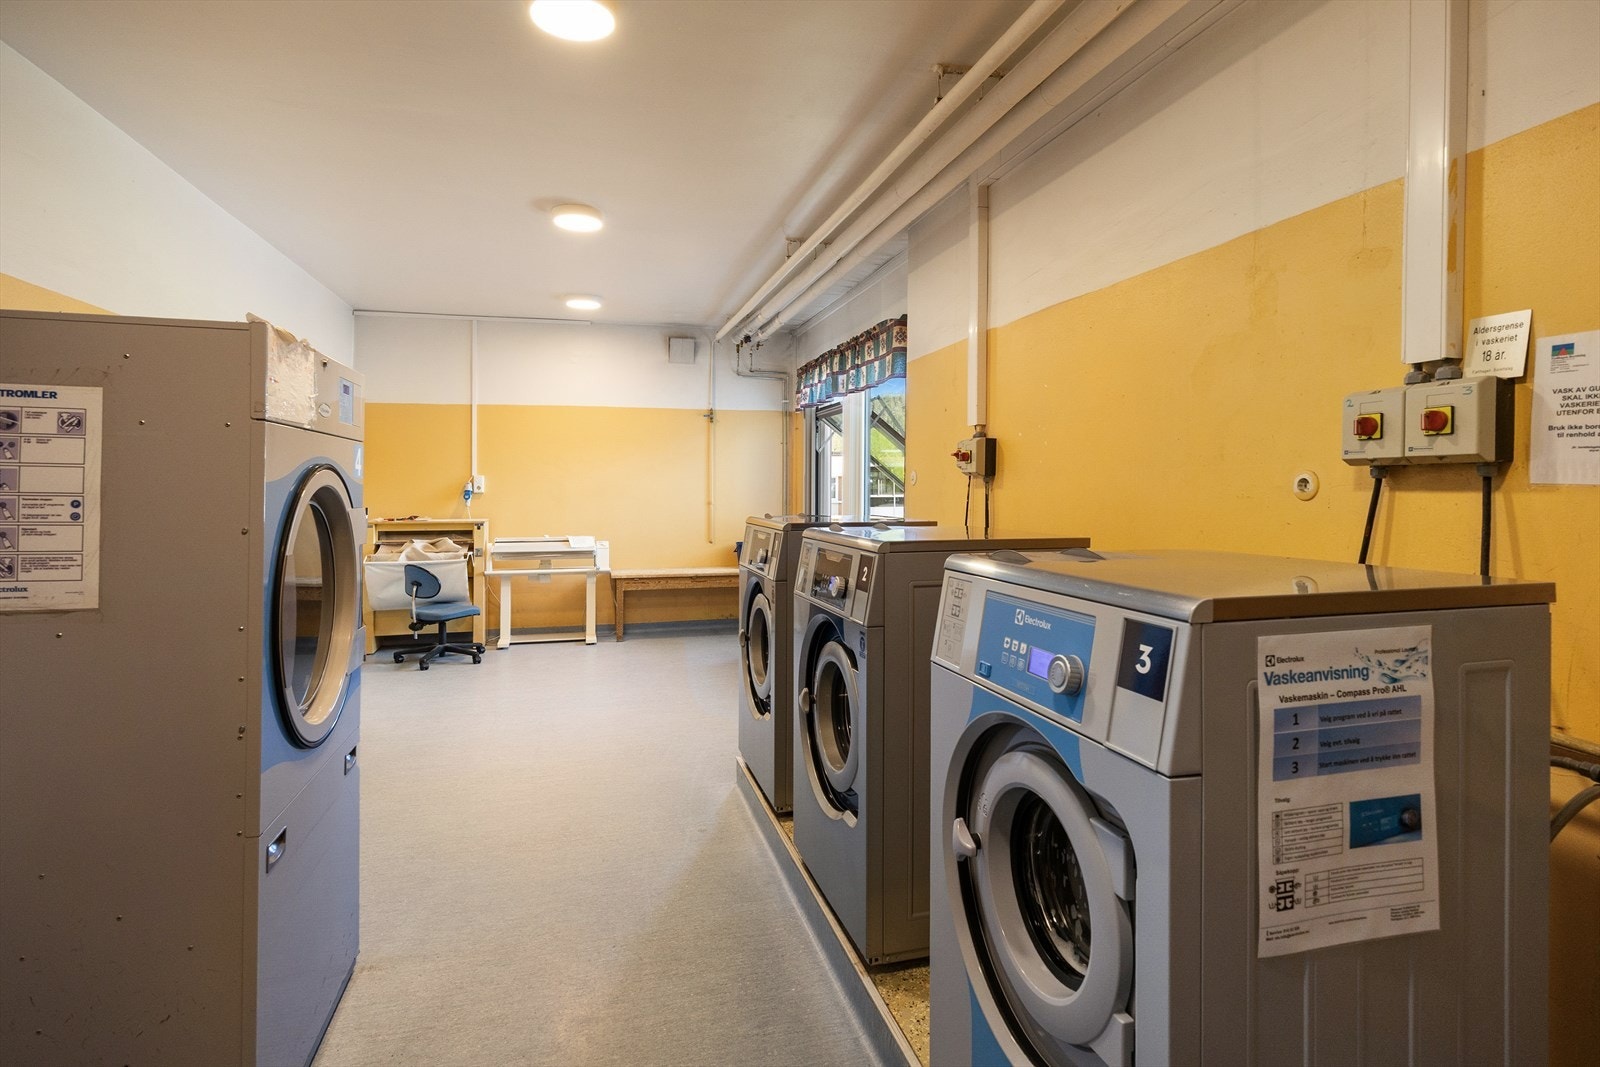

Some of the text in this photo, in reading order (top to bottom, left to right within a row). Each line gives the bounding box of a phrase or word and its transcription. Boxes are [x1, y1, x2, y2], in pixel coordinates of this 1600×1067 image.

[1473, 322, 1524, 335] Aldersgrense
[1482, 334, 1518, 346] vaskeriet
[1482, 350, 1492, 362] 18
[0, 389, 57, 399] TROMLER
[1462, 386, 1473, 395] 3
[1346, 399, 1354, 407] 2
[355, 447, 362, 476] 4
[861, 566, 868, 582] 2
[1025, 614, 1051, 630] Electrolux
[1135, 644, 1154, 674] 3
[1276, 656, 1304, 664] Electrolux
[1264, 665, 1369, 686] Vaskeanvisning
[1279, 692, 1328, 703] Vaskemaskin
[1336, 690, 1371, 698] Compass
[1292, 714, 1299, 725] 1
[1320, 715, 1331, 723] Velg
[1333, 714, 1355, 722] program
[1380, 709, 1386, 717] på
[1292, 738, 1299, 749] 2
[1291, 761, 1299, 773] 3
